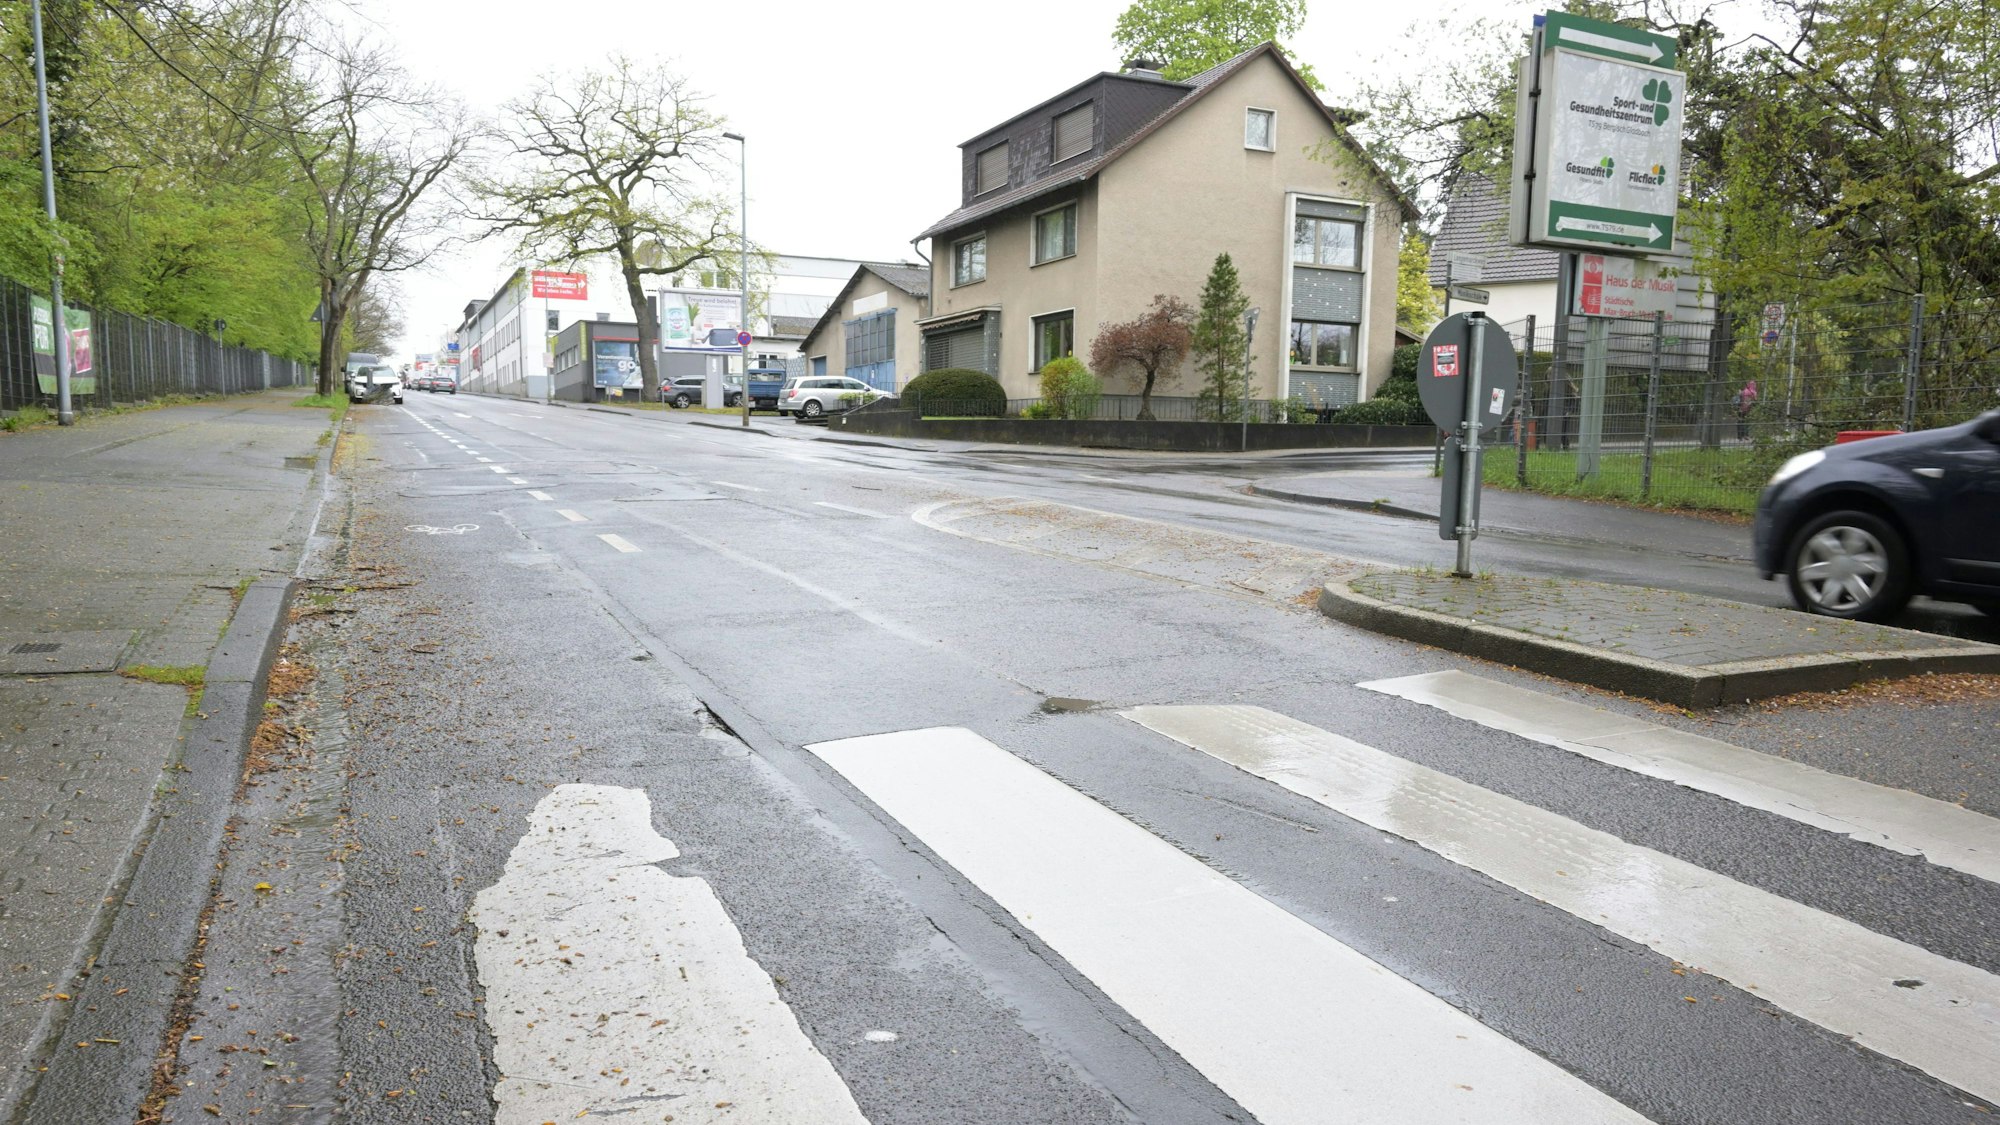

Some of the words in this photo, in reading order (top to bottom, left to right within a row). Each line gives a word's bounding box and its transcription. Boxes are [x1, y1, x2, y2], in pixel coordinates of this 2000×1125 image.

[1570, 101, 1653, 125] Gesundheitszentrum
[1640, 103, 1654, 113] und
[1566, 162, 1606, 178] Gesundfit
[1629, 172, 1657, 185] Flicflac
[1586, 223, 1625, 234] www.TS79.de
[1606, 275, 1628, 287] Haus
[1631, 276, 1645, 289] der
[1648, 279, 1675, 292] Musik
[1604, 296, 1634, 306] Städtische
[617, 360, 636, 372] go
